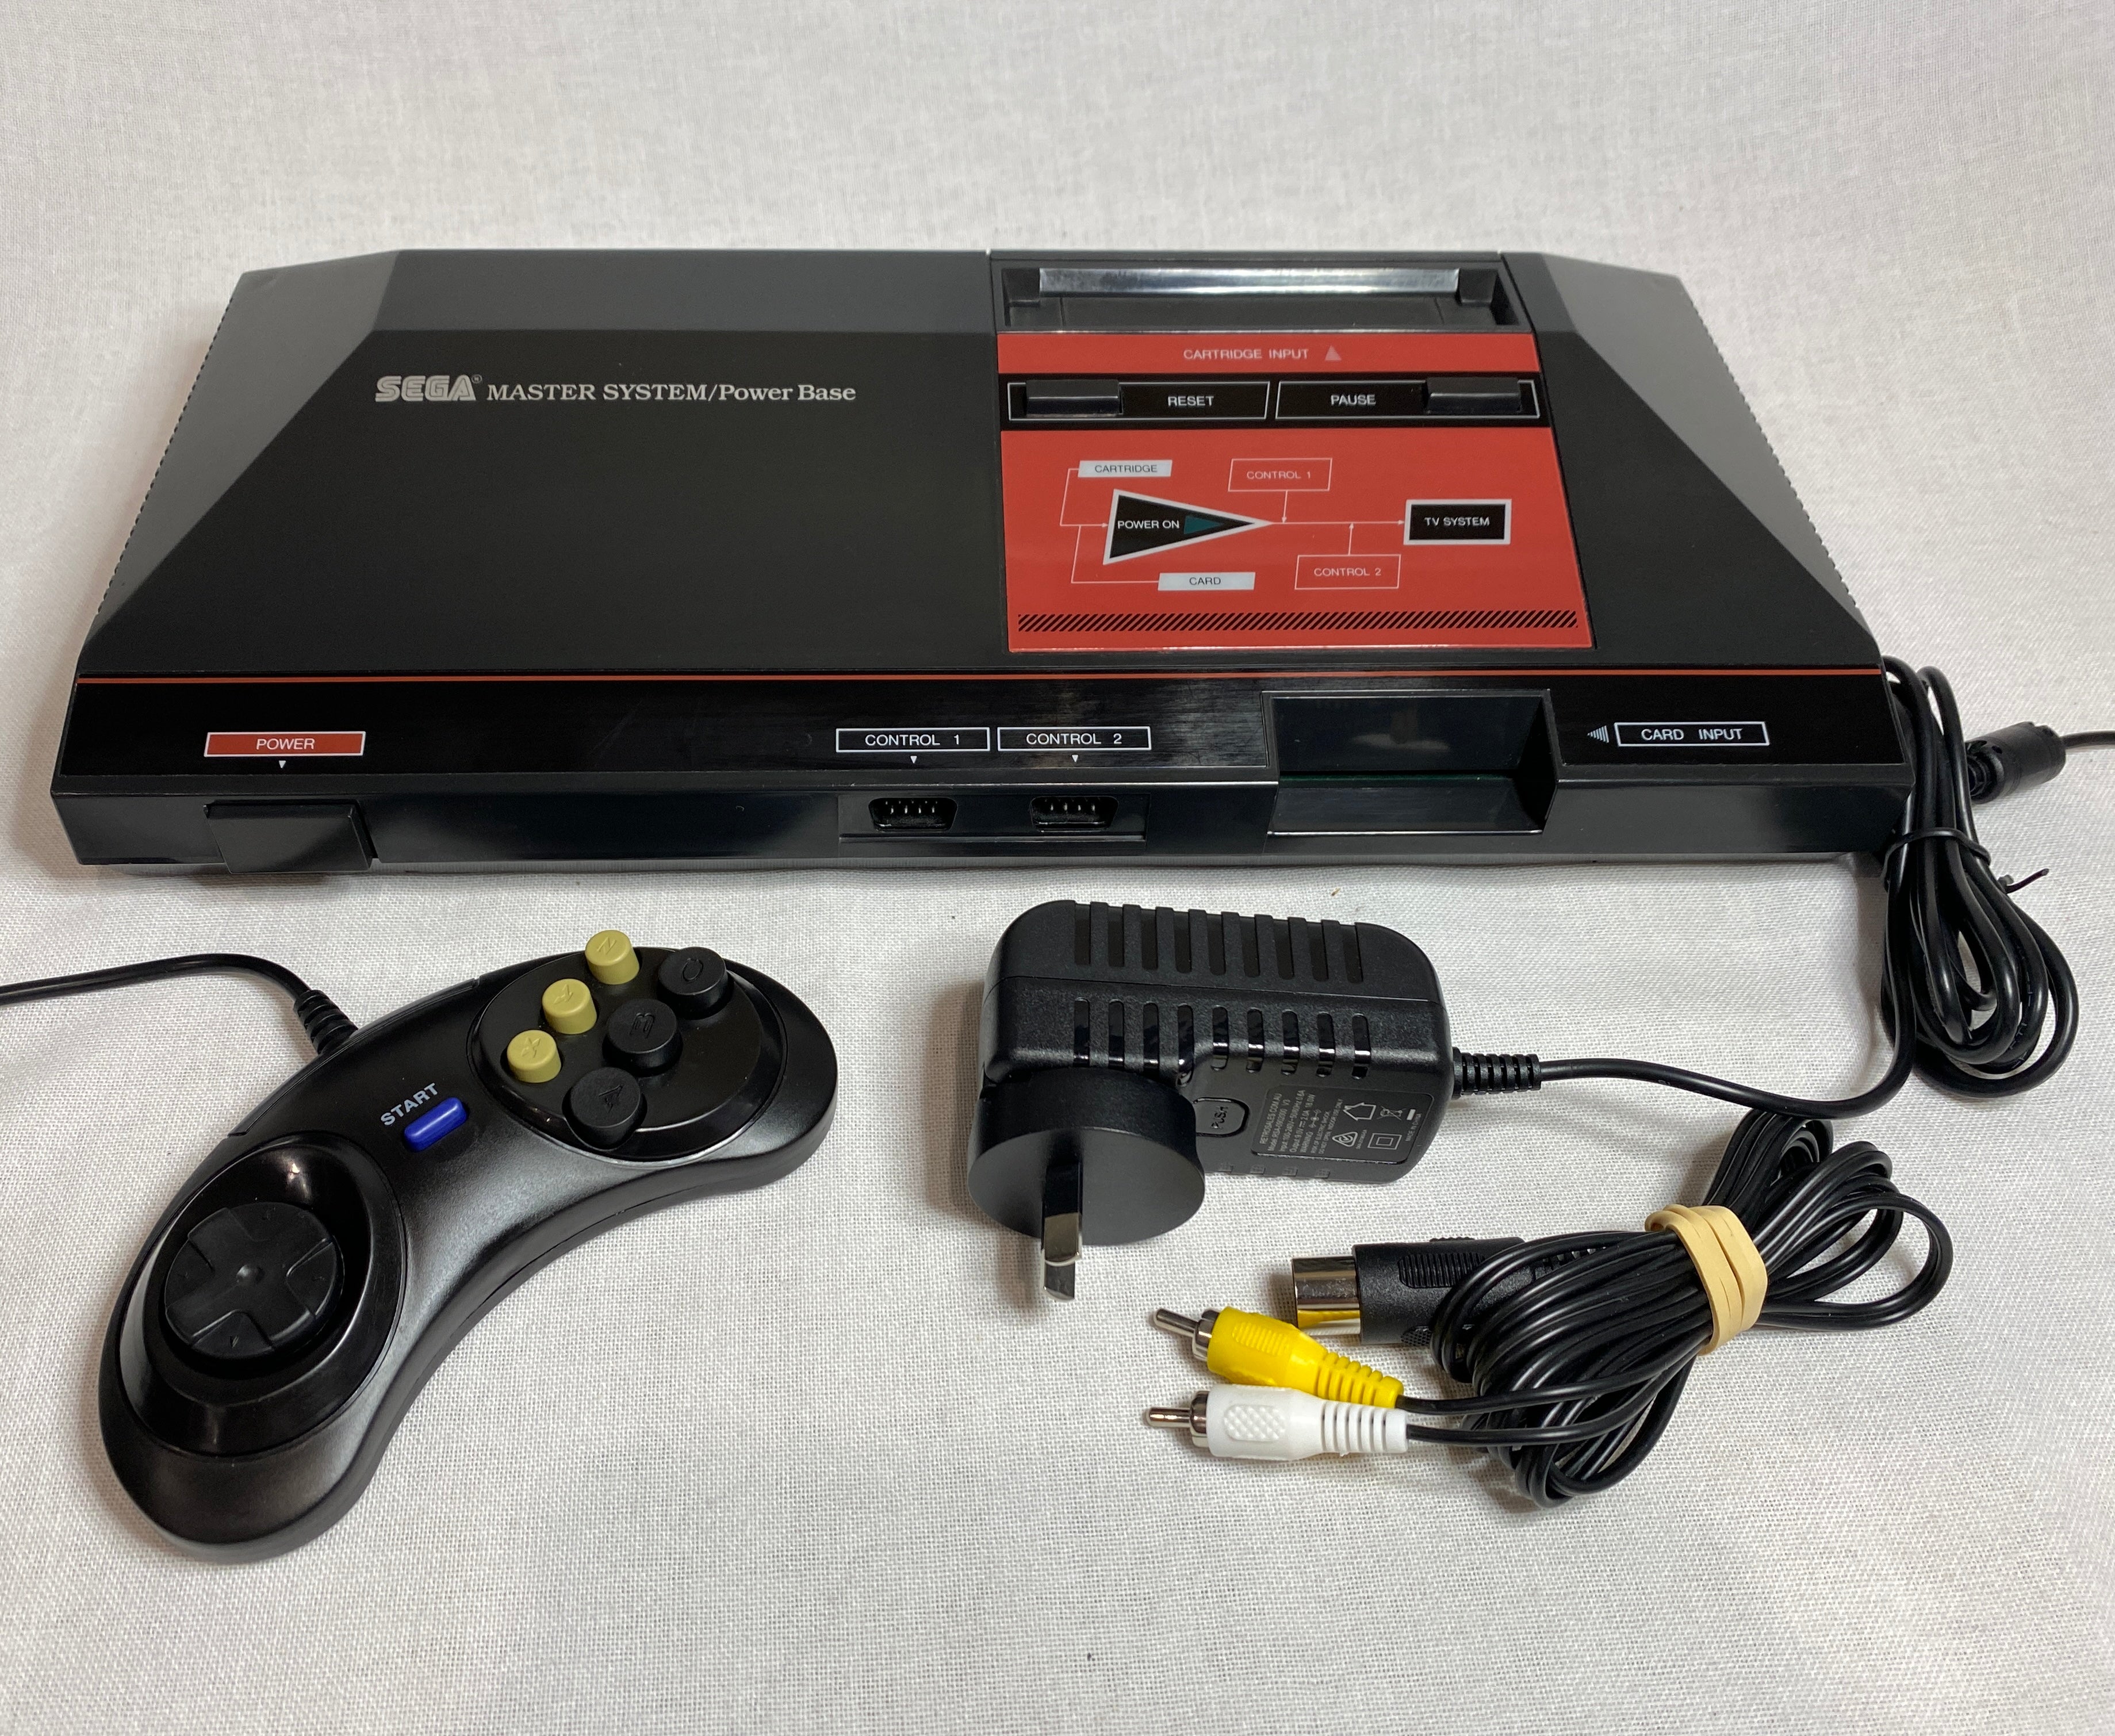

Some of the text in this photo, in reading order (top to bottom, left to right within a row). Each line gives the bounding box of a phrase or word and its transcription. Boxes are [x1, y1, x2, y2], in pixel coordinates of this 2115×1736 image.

[1183, 348, 1309, 359] CARTRIDGE INPUT
[486, 384, 596, 400] MASTER
[603, 384, 794, 401] SYSTEM/Power
[798, 384, 856, 401] Base
[1167, 396, 1214, 407] RESET
[1331, 394, 1376, 405] PAUSE
[1094, 465, 1157, 473] CARTRIDGE
[1246, 470, 1311, 480] CONTROL 1
[1117, 519, 1180, 530] POWER ON
[1424, 517, 1490, 526] TV SYSTEM
[1313, 568, 1381, 577] CONTROL 2
[1189, 577, 1221, 585] CARD
[864, 734, 959, 746] CONTROL 1
[1026, 733, 1122, 745] CONTROL 2
[1641, 728, 1742, 741] CARD INPUT
[256, 738, 315, 750] POWER
[381, 1082, 438, 1126] START
